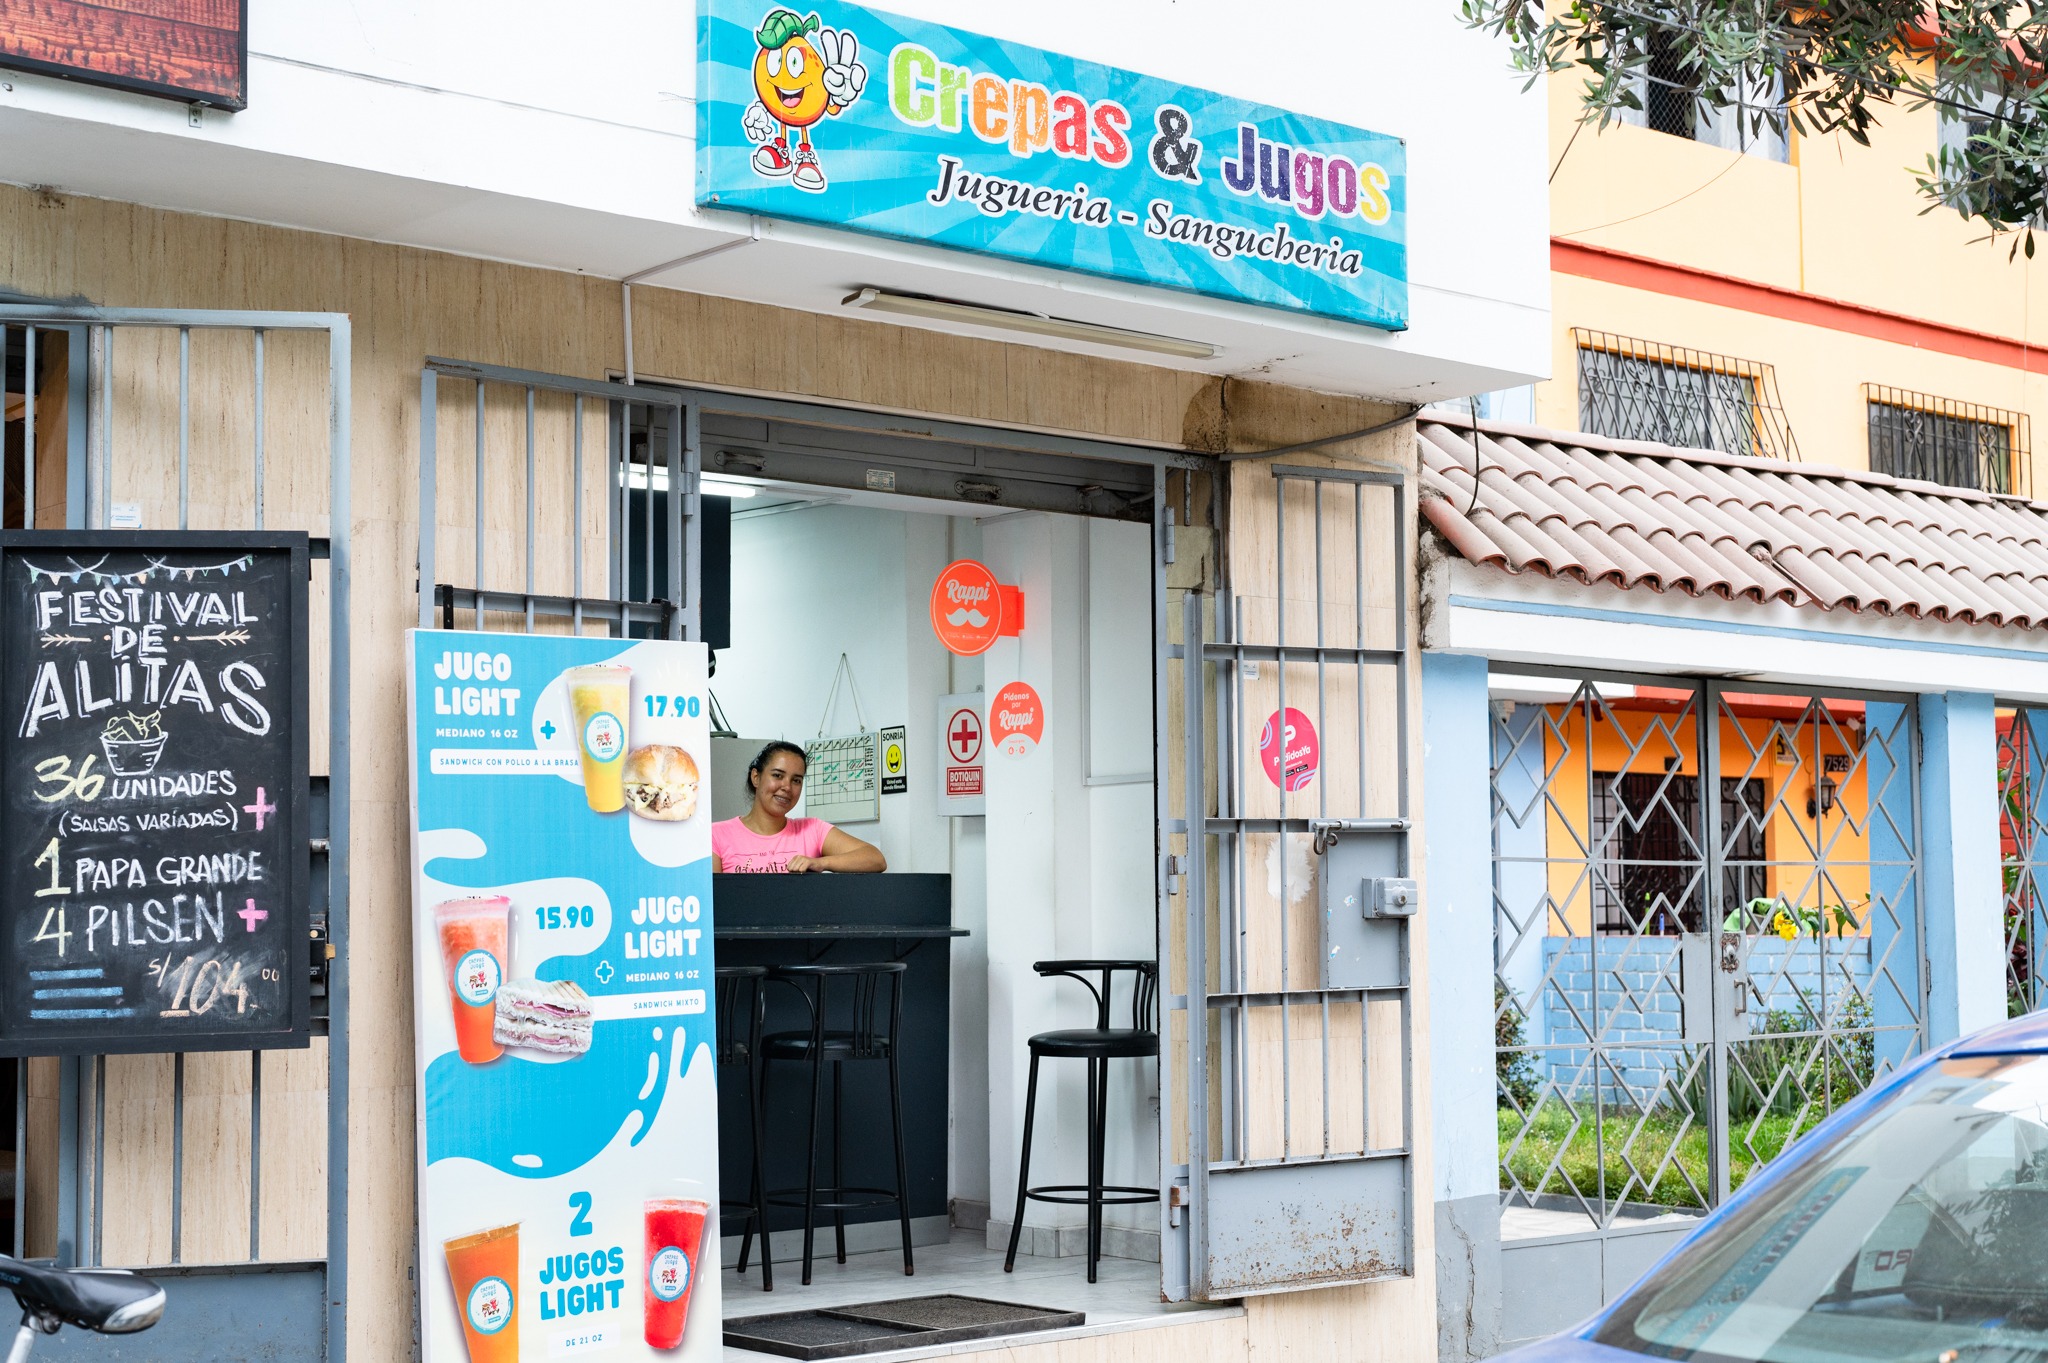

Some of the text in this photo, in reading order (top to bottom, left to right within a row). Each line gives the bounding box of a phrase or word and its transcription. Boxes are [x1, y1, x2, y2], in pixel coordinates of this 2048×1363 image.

[891, 45, 1390, 222] Crepas & Jugos
[930, 157, 1107, 224] Jugueria
[1147, 202, 1361, 275] Sangucheria
[946, 579, 990, 606] Rappi
[35, 588, 258, 630] FESTIVAL
[111, 624, 168, 659] DE
[434, 651, 512, 682] JUGO
[434, 686, 521, 716] LIGHT
[644, 695, 700, 718] 17.90
[436, 728, 518, 738] MEDIANO 16 OZ
[999, 707, 1034, 731] Rappi
[440, 758, 482, 766] SANDWICH
[554, 759, 579, 767] BRASA
[1273, 745, 1311, 766] PdidosYa
[1825, 756, 1849, 771] 7529
[34, 754, 106, 802] 36
[34, 837, 71, 898] 1
[75, 851, 263, 893] PAPA GRANDE
[86, 891, 224, 951] PILSEN
[535, 905, 594, 930] 15.90
[631, 895, 700, 925] JUGO
[31, 907, 72, 957] 4
[624, 928, 701, 960] LIGHT
[626, 970, 699, 982] MEDIANO 16 OZ
[633, 998, 699, 1010] SANDWICH MIXTO
[568, 1191, 593, 1237] 2
[539, 1246, 625, 1285] JUGOS
[539, 1279, 625, 1321] LIGHT
[565, 1333, 602, 1347] DE 21 OZ
